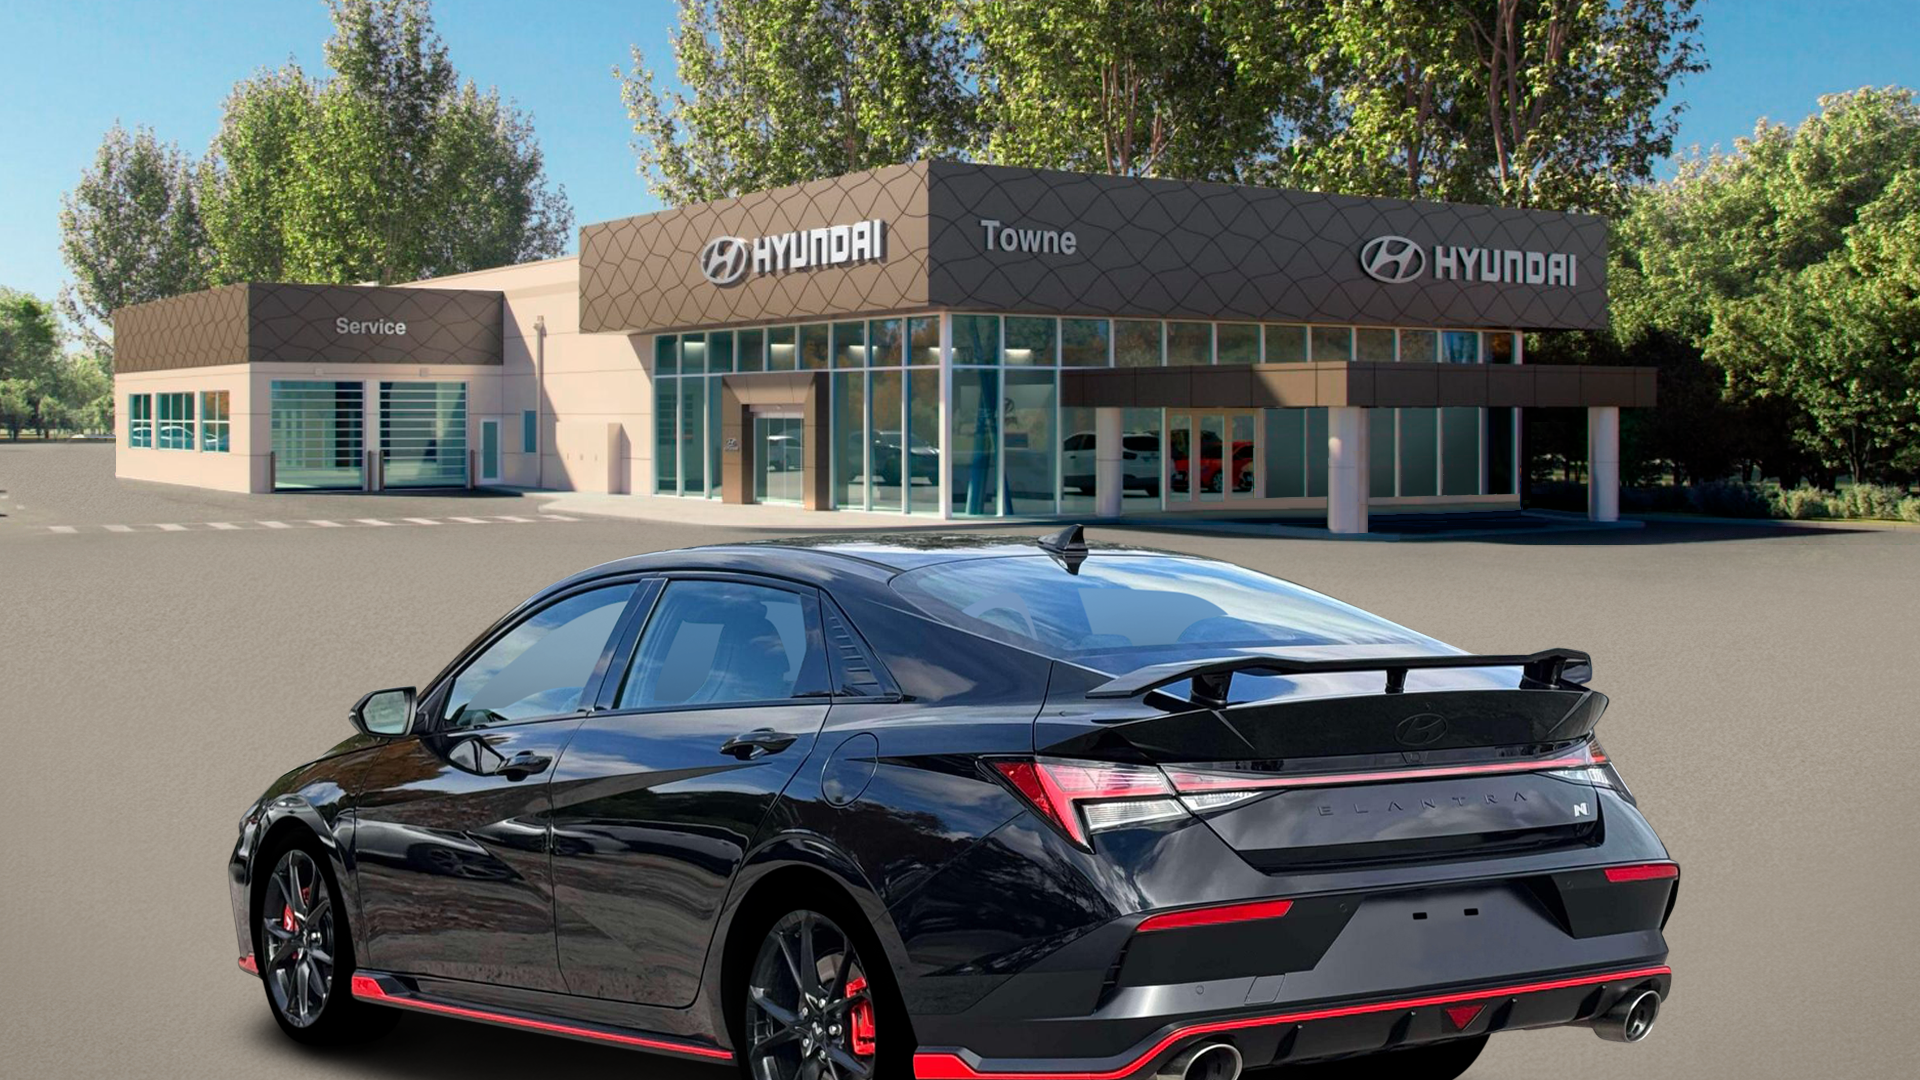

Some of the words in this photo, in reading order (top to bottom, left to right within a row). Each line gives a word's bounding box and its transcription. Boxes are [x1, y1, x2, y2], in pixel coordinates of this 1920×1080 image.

[752, 218, 884, 275] HYUNDAI
[979, 219, 1077, 255] Towne
[1433, 245, 1577, 287] HYUNDAI
[335, 316, 407, 335] Service
[1317, 790, 1528, 817] ELANTRA
